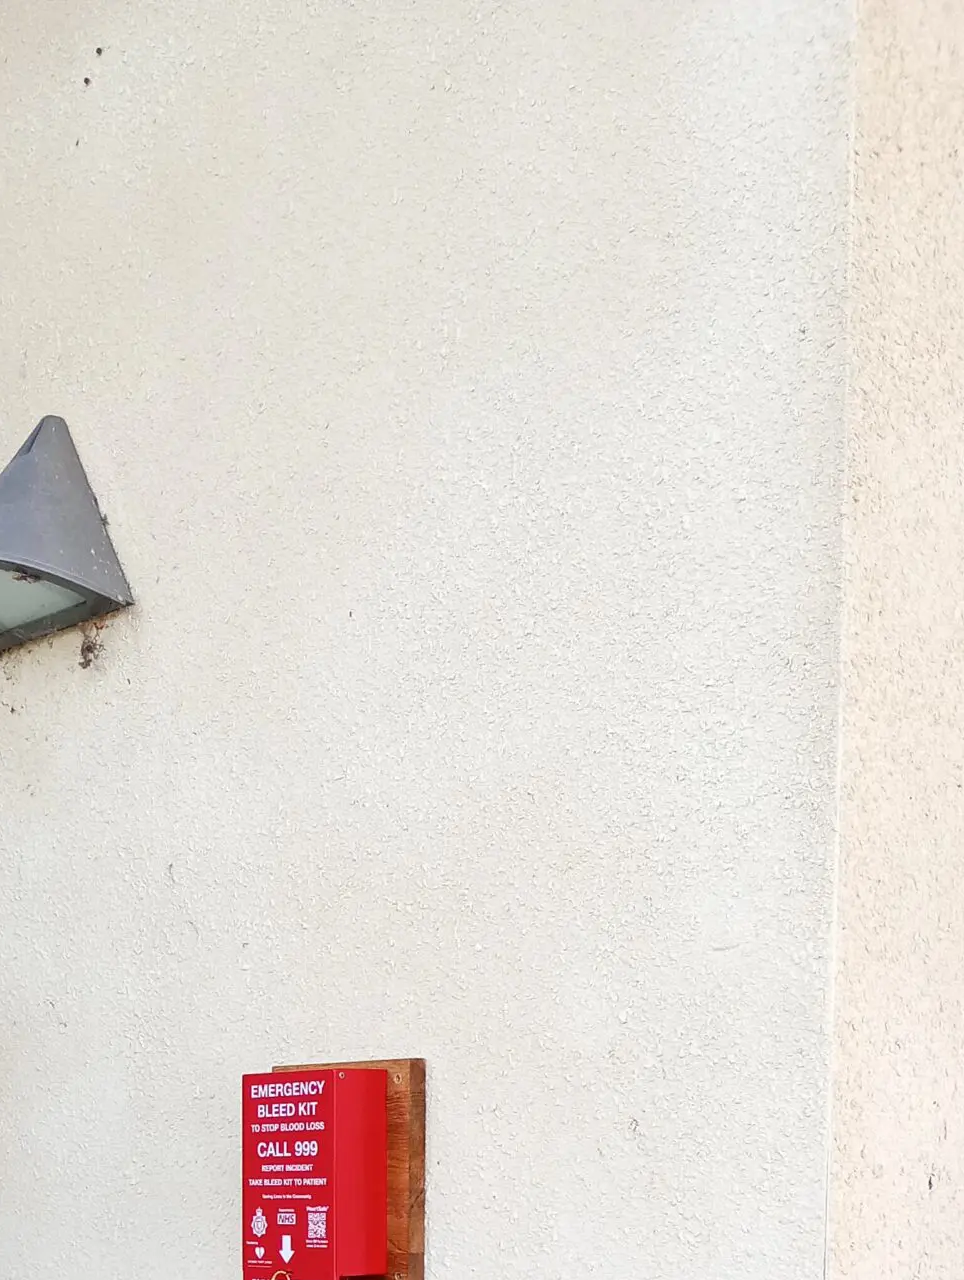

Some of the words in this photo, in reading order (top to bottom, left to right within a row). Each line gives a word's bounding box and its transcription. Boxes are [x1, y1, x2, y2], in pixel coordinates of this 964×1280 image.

[251, 1080, 326, 1099] EMERGENCY
[257, 1103, 296, 1118] BLEED
[298, 1101, 318, 1116] KIT
[251, 1124, 261, 1133] TO
[261, 1123, 280, 1132] STOP
[280, 1122, 305, 1131] BLOOD
[306, 1121, 325, 1130] LOSS
[257, 1142, 292, 1157] CALL
[294, 1140, 318, 1156] 999
[261, 1164, 284, 1172] REPORT
[285, 1163, 313, 1171] INCIDENT
[248, 1178, 264, 1186] TAKE
[264, 1178, 283, 1186] BLEED
[283, 1178, 293, 1186] KIT
[293, 1178, 303, 1186] TO
[303, 1177, 327, 1185] PATIENT
[279, 1215, 294, 1223] NHS
